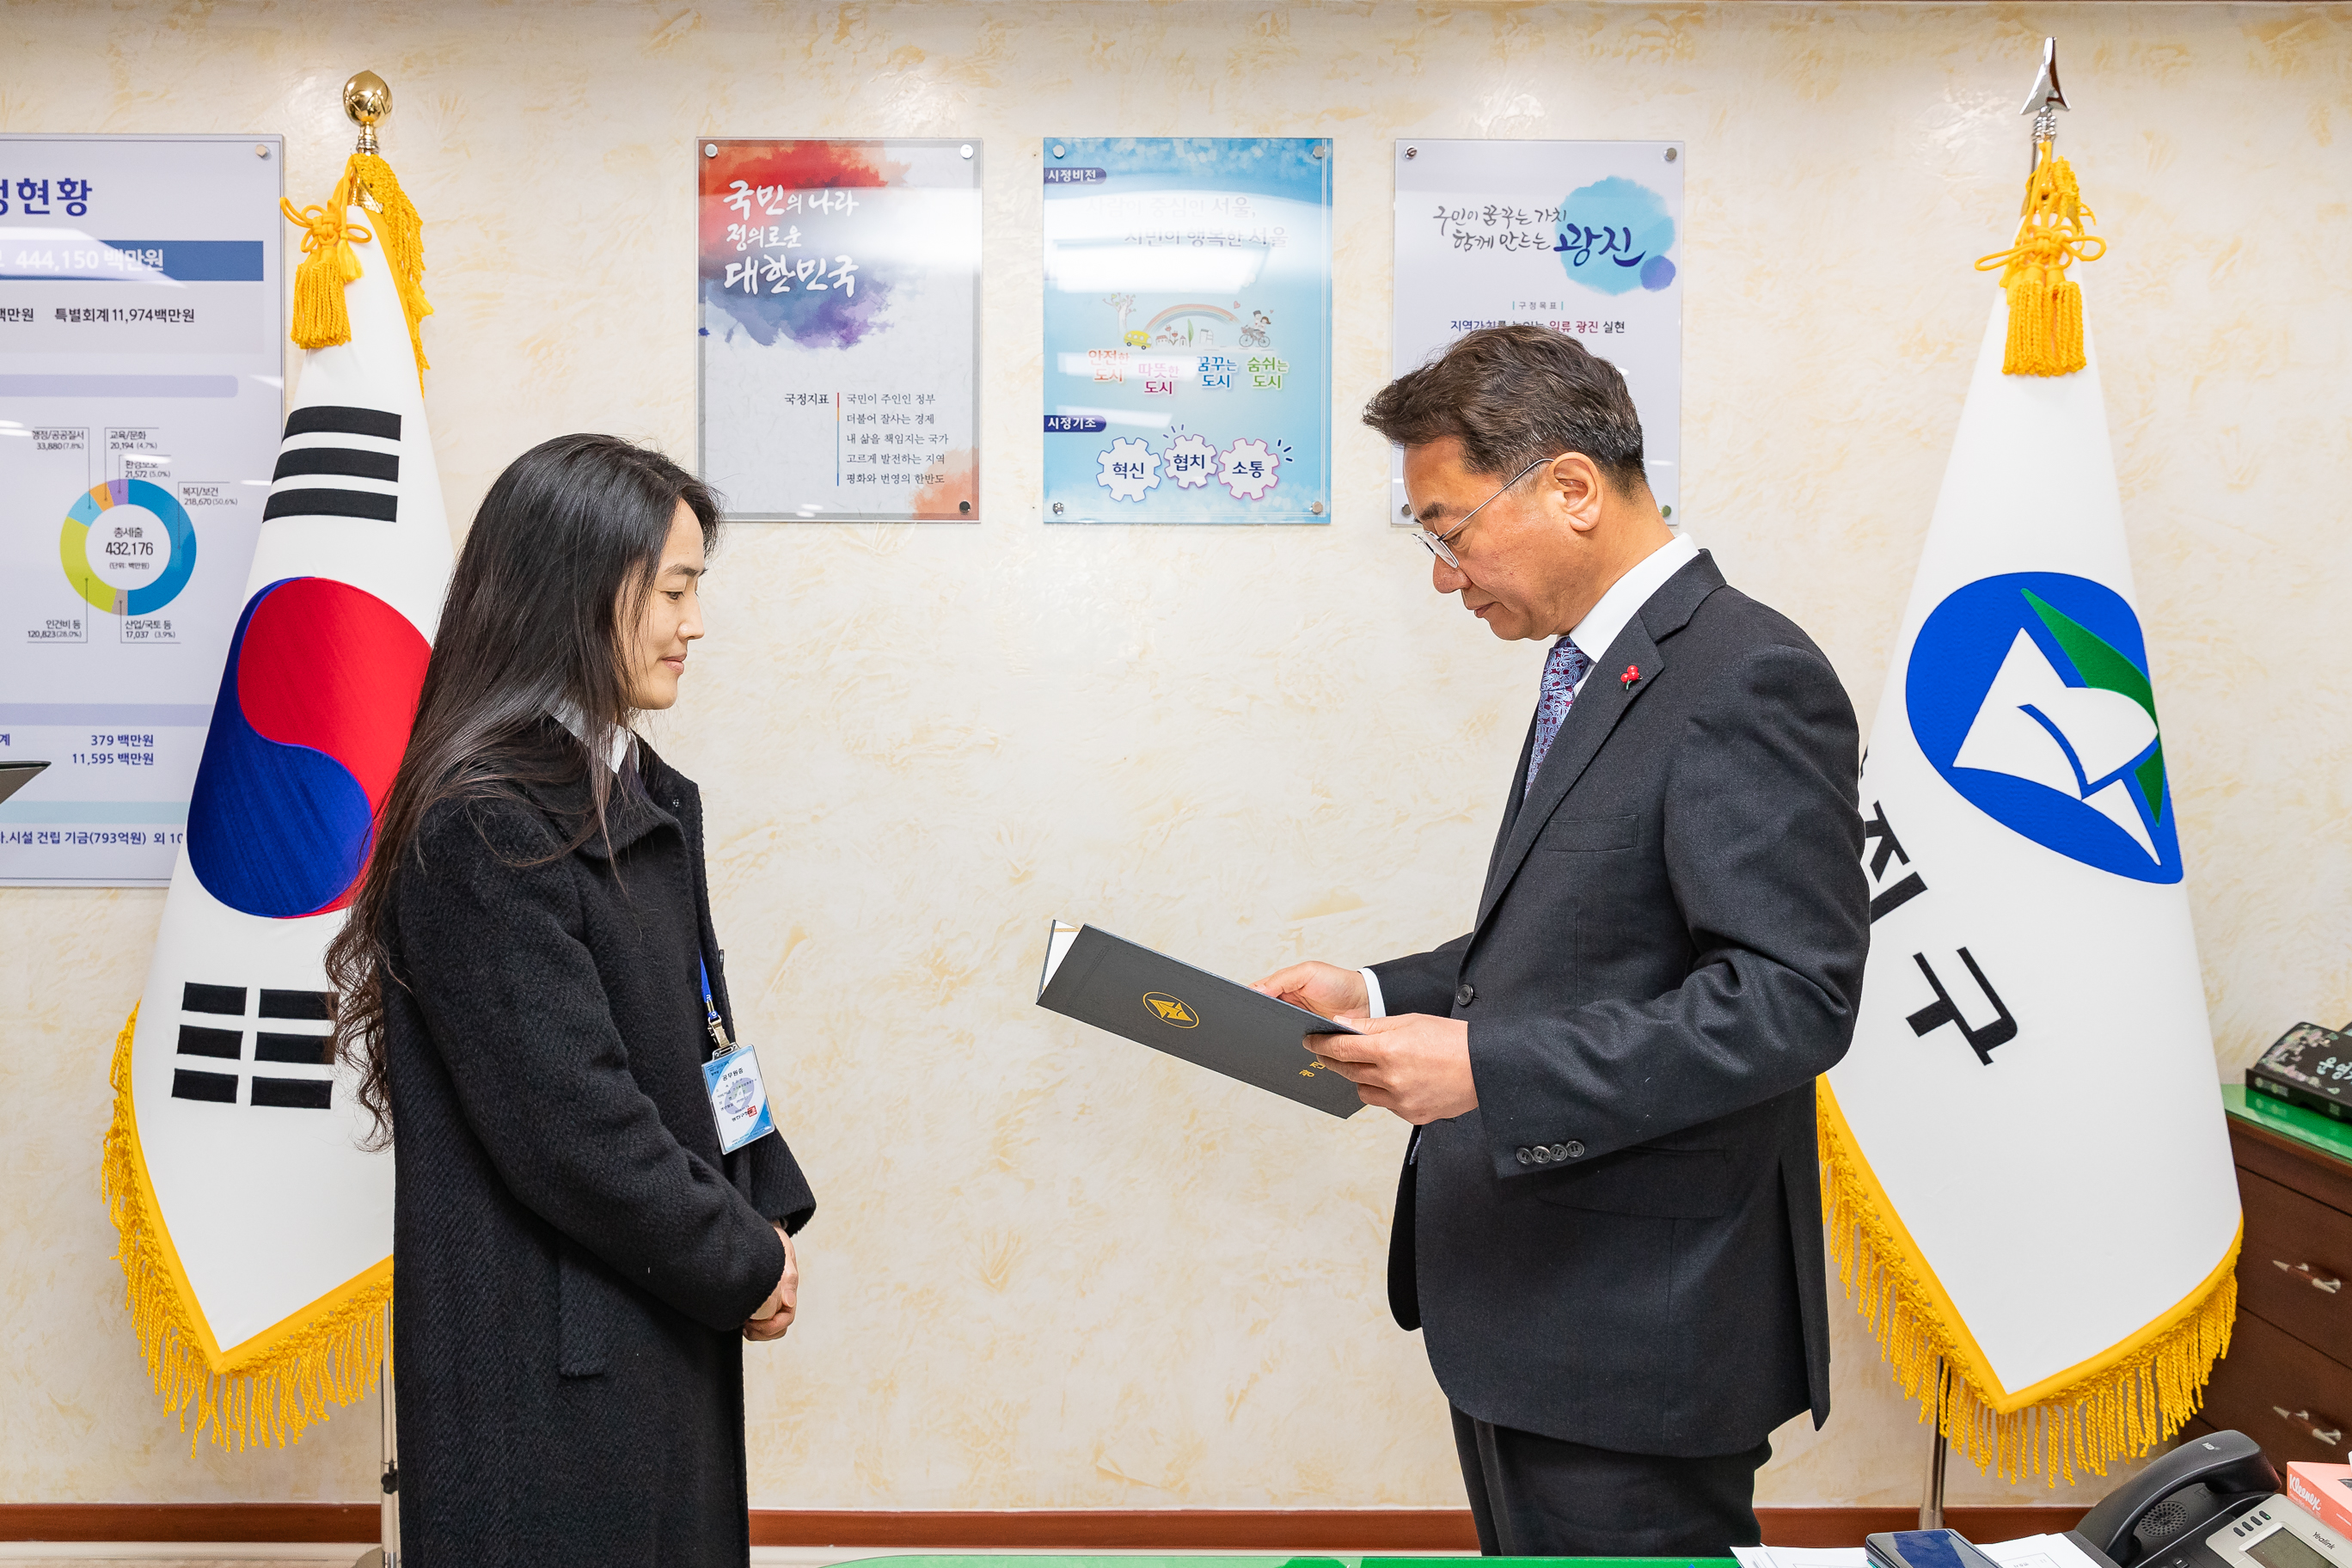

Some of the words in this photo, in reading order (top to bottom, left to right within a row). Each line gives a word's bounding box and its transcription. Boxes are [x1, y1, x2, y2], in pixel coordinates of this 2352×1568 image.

[1048, 169, 1097, 182] 시정비전
[0, 178, 92, 216] 현황
[723, 180, 802, 220] 국민의
[808, 189, 860, 216] 나라
[1211, 196, 1256, 218] 서울,
[1433, 205, 1478, 236] 구민이
[1483, 204, 1532, 229] 꿈꾸는
[1534, 207, 1567, 223] 가치
[726, 223, 802, 251] 정의로운
[1248, 226, 1289, 248] 서울
[1453, 229, 1494, 252] 함께
[1499, 231, 1551, 251] 만드는
[1553, 224, 1646, 267] 광진
[15, 250, 99, 272] 444,150
[104, 248, 163, 272] 백만원
[724, 254, 859, 297] 대한민국
[1519, 302, 1557, 310] 구정목표
[54, 308, 109, 323] 특별회계
[1576, 321, 1599, 334] 광진
[1603, 321, 1625, 334] 실현
[1088, 349, 1130, 366] 안전한
[1197, 356, 1237, 372] 꿈꾸는
[1247, 356, 1289, 373] 숨쉬는
[1094, 369, 1124, 383] 도시
[1138, 363, 1179, 378] 따뜻한
[1144, 381, 1173, 395] 도시
[1202, 374, 1231, 388] 도시
[1253, 375, 1282, 389] 도시
[784, 393, 830, 405] 국정지표
[847, 394, 877, 405] 국민이
[880, 394, 911, 405] 주인인
[916, 394, 935, 405] 정부
[847, 413, 877, 425] 더불어
[880, 413, 910, 425] 잘사는
[915, 413, 934, 425] 경제
[1048, 416, 1097, 430] 시정기조
[847, 433, 856, 444] 내
[861, 433, 880, 444] 삶을
[884, 433, 924, 444] 책임지는
[928, 433, 949, 444] 국가
[847, 454, 877, 464] 고르게
[880, 454, 922, 464] 발전하는
[926, 454, 945, 464] 지역
[1173, 453, 1205, 471] 협치
[1112, 462, 1144, 479] 혁신
[1233, 461, 1265, 478] 소통
[846, 474, 877, 485] 평화와
[880, 474, 910, 485] 번영의
[915, 474, 945, 485] 한반도
[106, 542, 154, 556] 432,176
[91, 735, 114, 746] 379
[117, 734, 154, 747] 백만원
[72, 753, 114, 766] 11,595
[117, 752, 154, 765] 백만원
[37, 831, 60, 844] 건립
[154, 831, 165, 845] 외
[2289, 1473, 2321, 1510] Kleenex
[2312, 1532, 2335, 1550] Yealink
